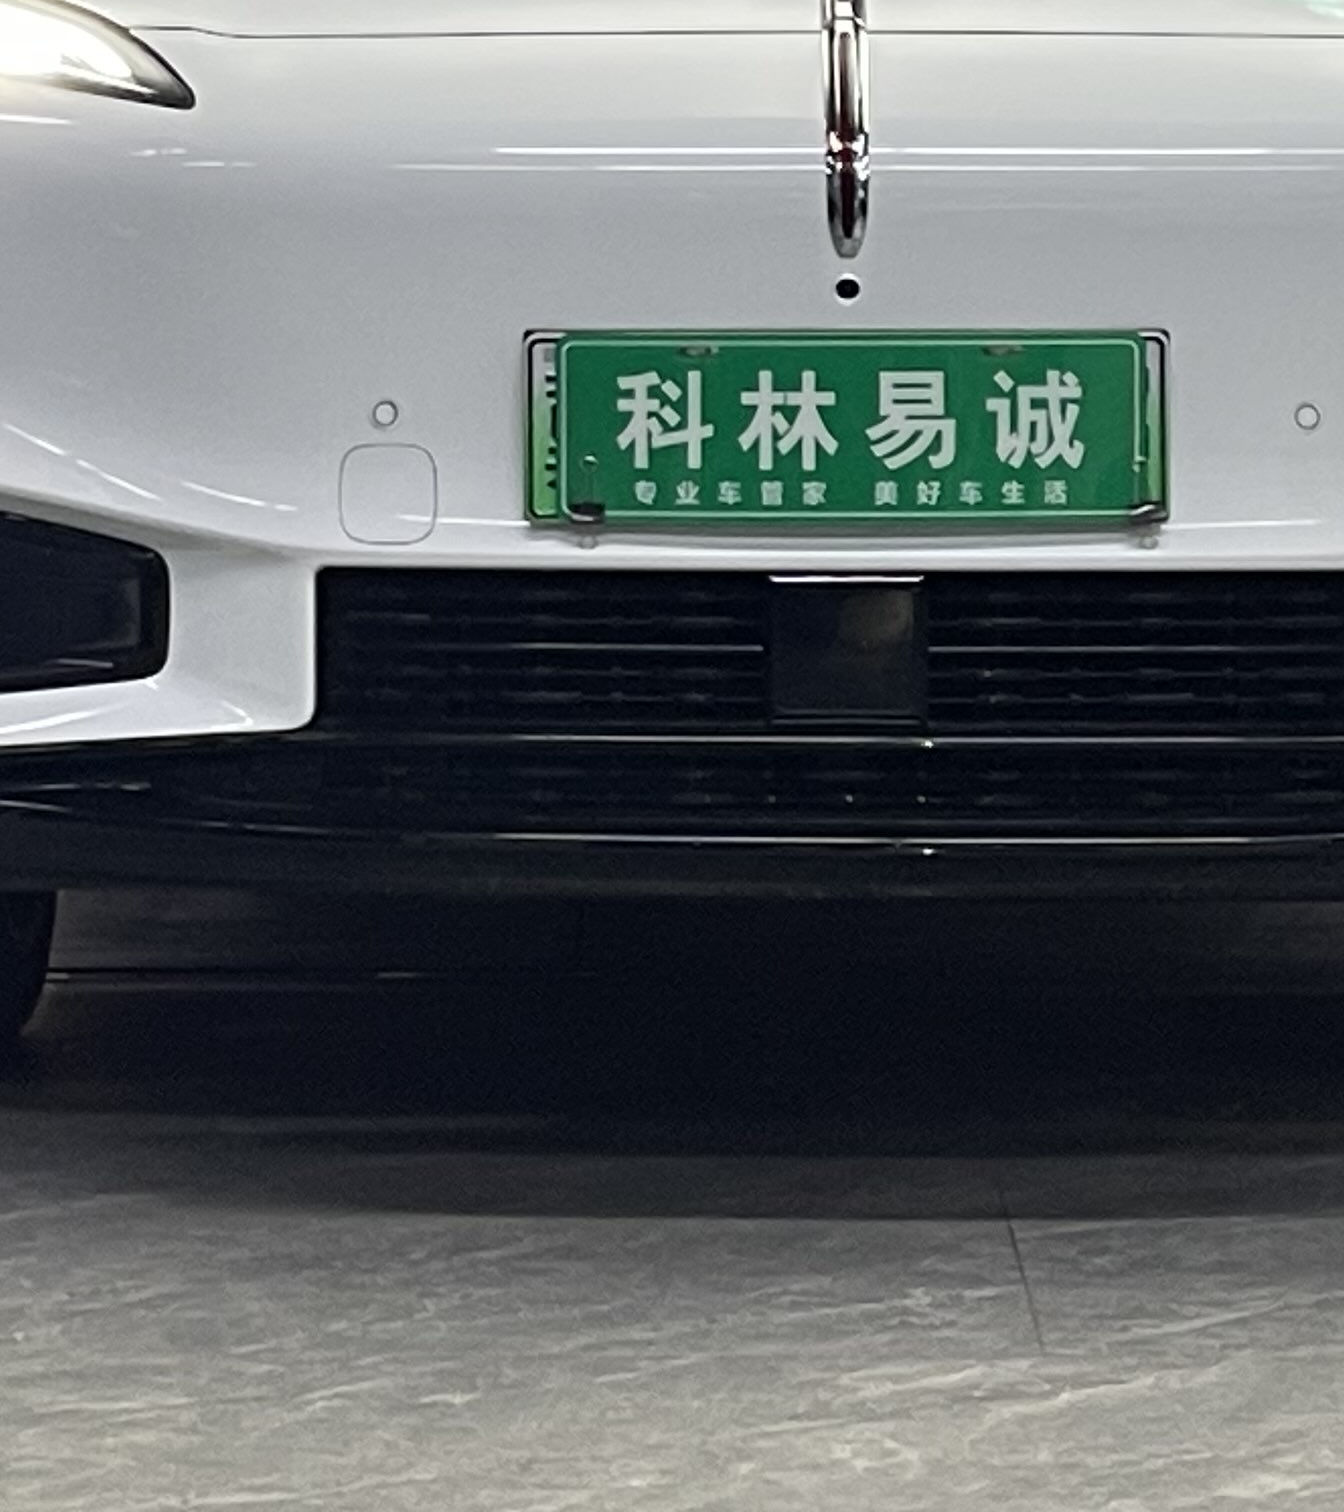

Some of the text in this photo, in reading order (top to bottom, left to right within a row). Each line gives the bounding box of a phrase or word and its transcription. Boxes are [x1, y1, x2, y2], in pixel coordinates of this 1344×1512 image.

[615, 369, 1085, 471] 科林易诚
[874, 479, 1068, 506] 美好车生活
